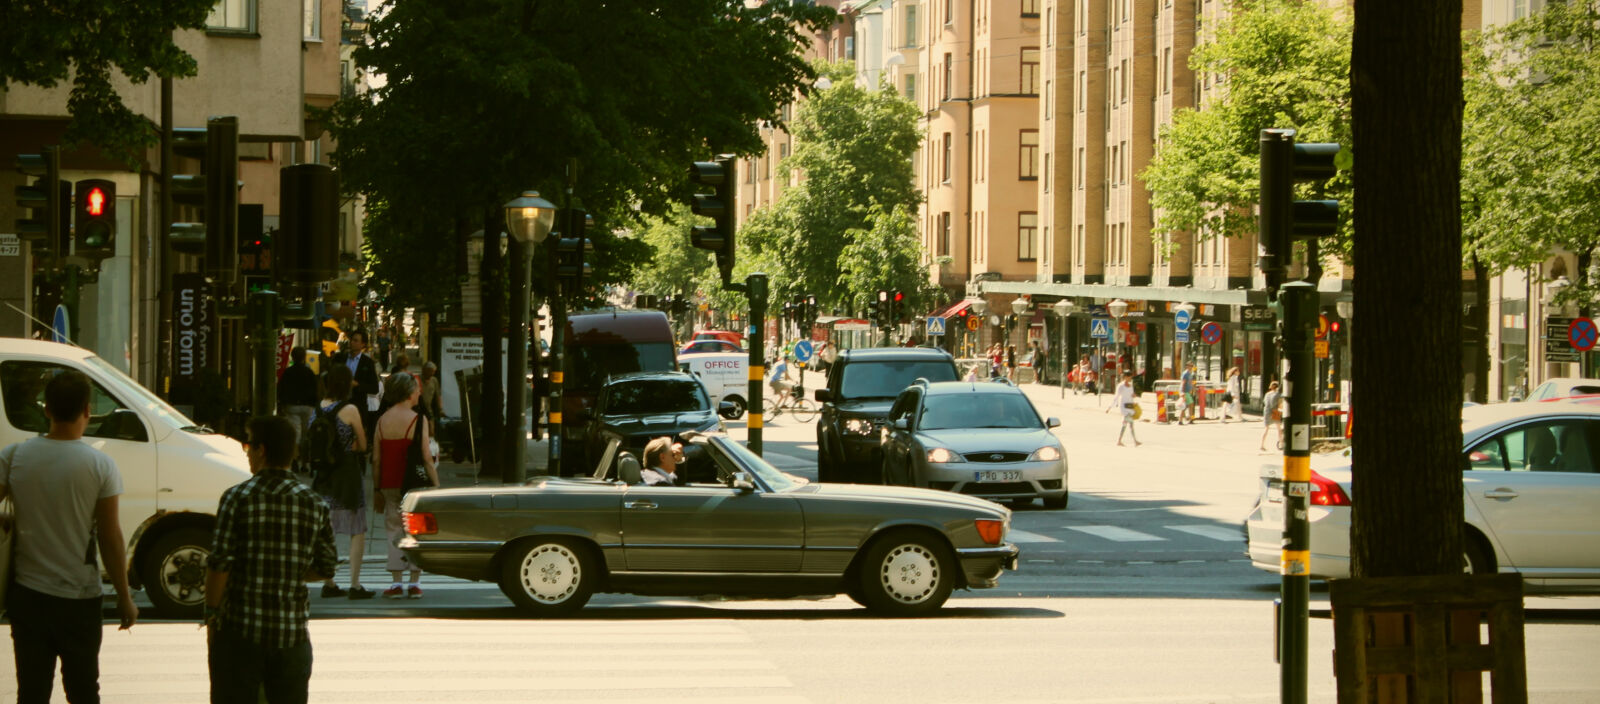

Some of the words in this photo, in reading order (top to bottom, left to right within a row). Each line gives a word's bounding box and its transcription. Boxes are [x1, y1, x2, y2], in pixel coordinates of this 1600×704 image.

[180, 288, 194, 326] uno
[1244, 309, 1272, 319] SEB
[180, 329, 197, 375] form
[704, 360, 740, 369] OFFICE
[1003, 472, 1019, 480] 337
